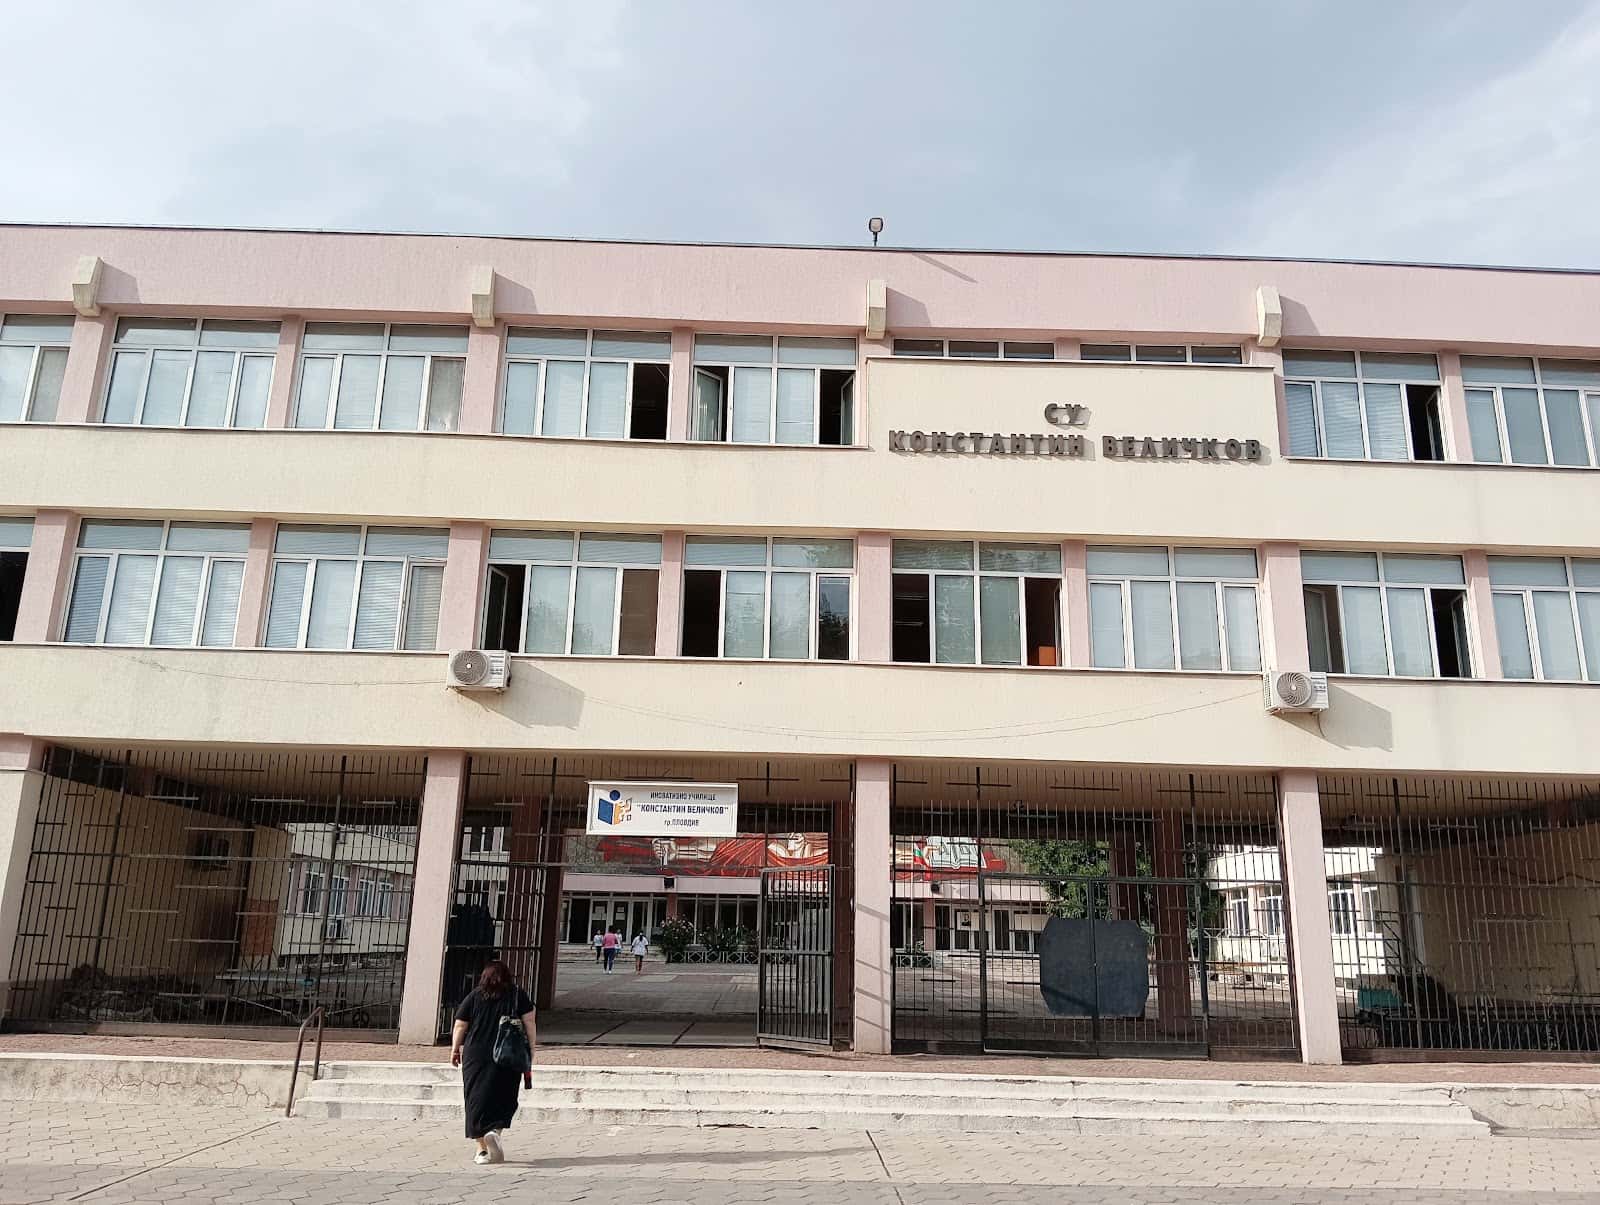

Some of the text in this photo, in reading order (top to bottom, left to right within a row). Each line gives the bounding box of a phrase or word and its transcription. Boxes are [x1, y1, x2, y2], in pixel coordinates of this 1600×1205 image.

[1044, 403, 1082, 425] СУ
[888, 430, 1262, 460] КОНСТАНТИН ВЕЛИЧКОВ
[650, 792, 716, 801] ИНОВАТИВНО УЧИЛИЩЕ
